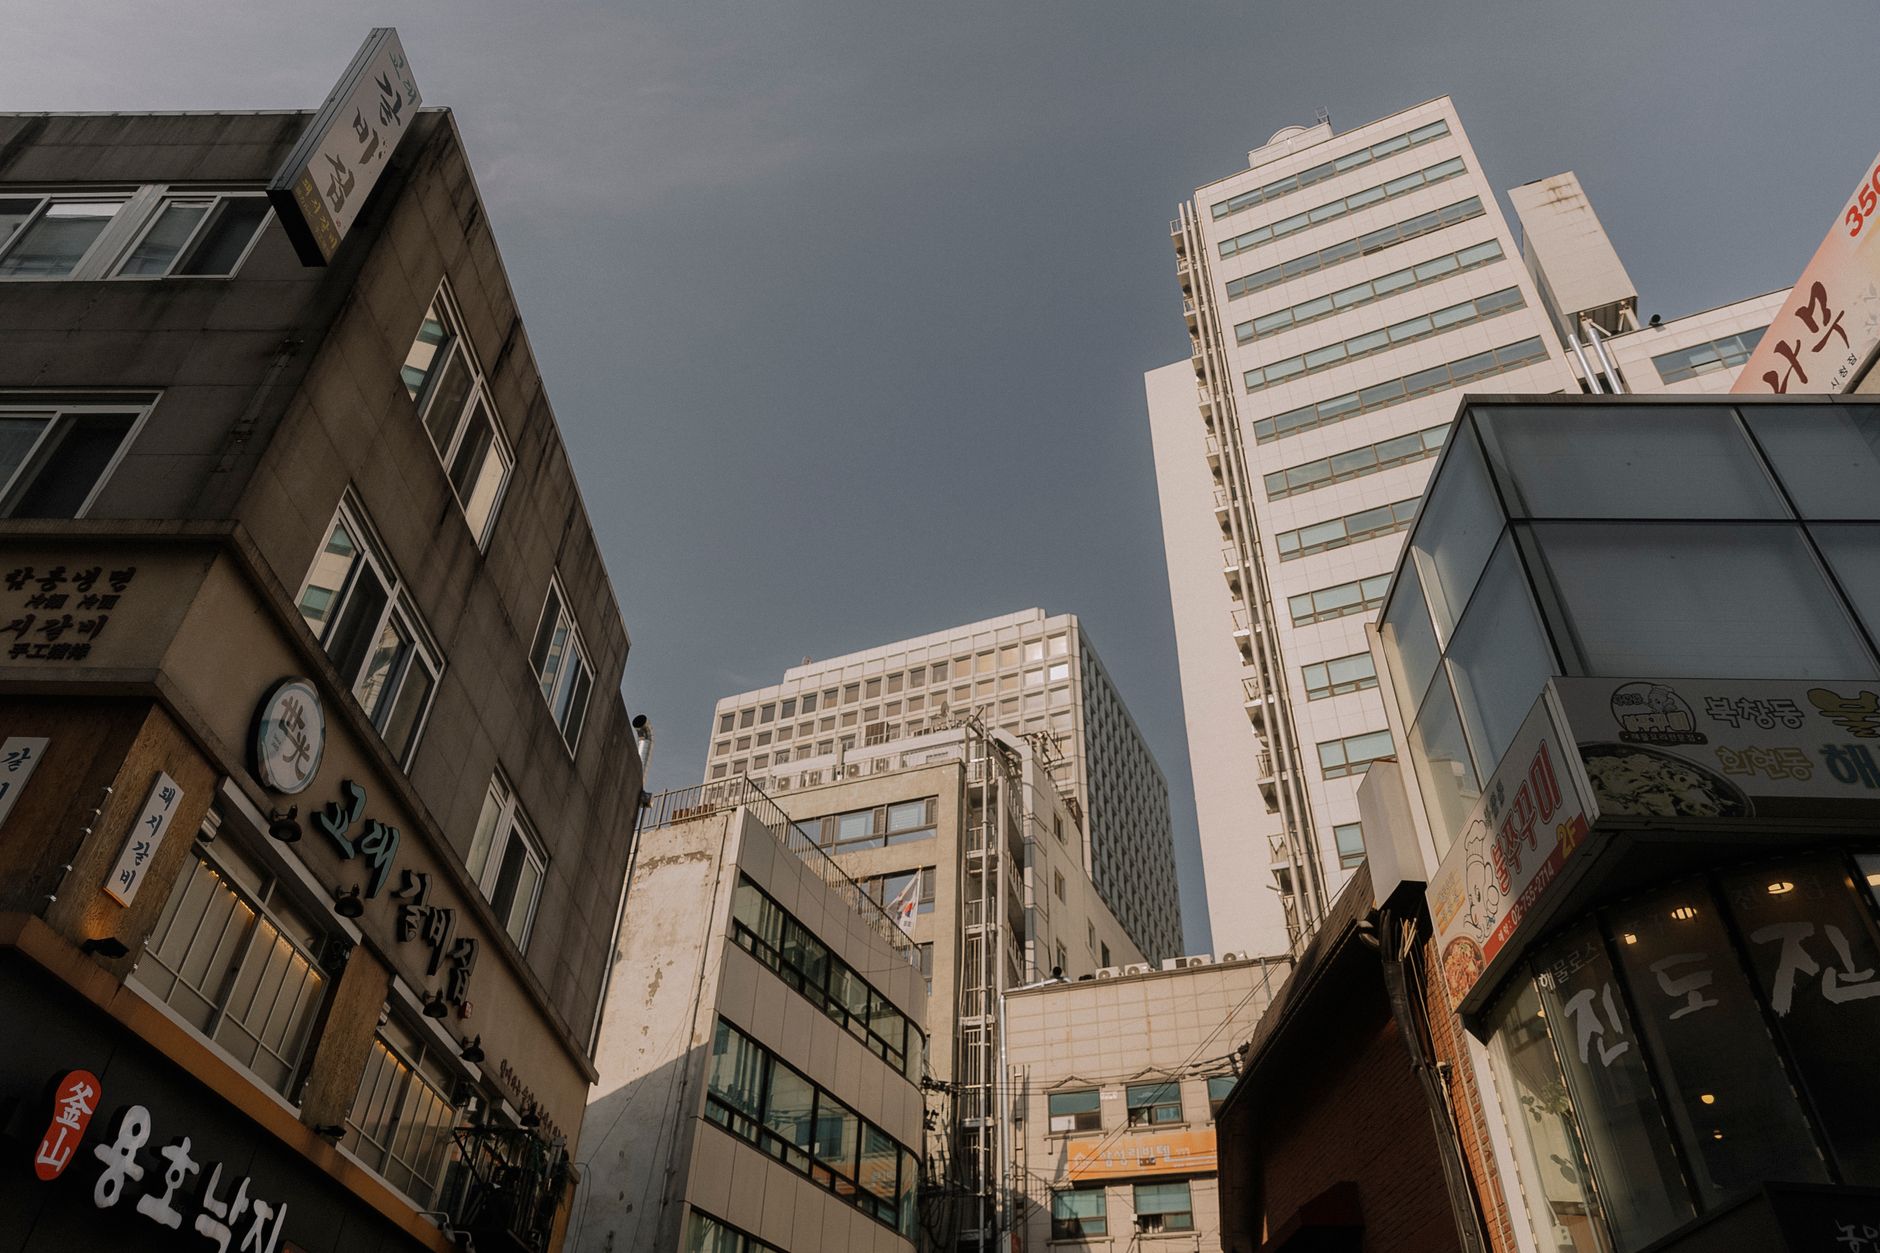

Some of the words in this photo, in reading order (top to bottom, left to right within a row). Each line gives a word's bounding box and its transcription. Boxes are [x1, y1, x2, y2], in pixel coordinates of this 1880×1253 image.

[325, 71, 403, 214] 갈비집
[1704, 696, 1805, 730] 북창동
[1715, 745, 1815, 782] 회현동
[1556, 816, 1576, 859] 2F
[37, 1081, 94, 1172] 釜山
[94, 1104, 288, 1253] 용호낙지
